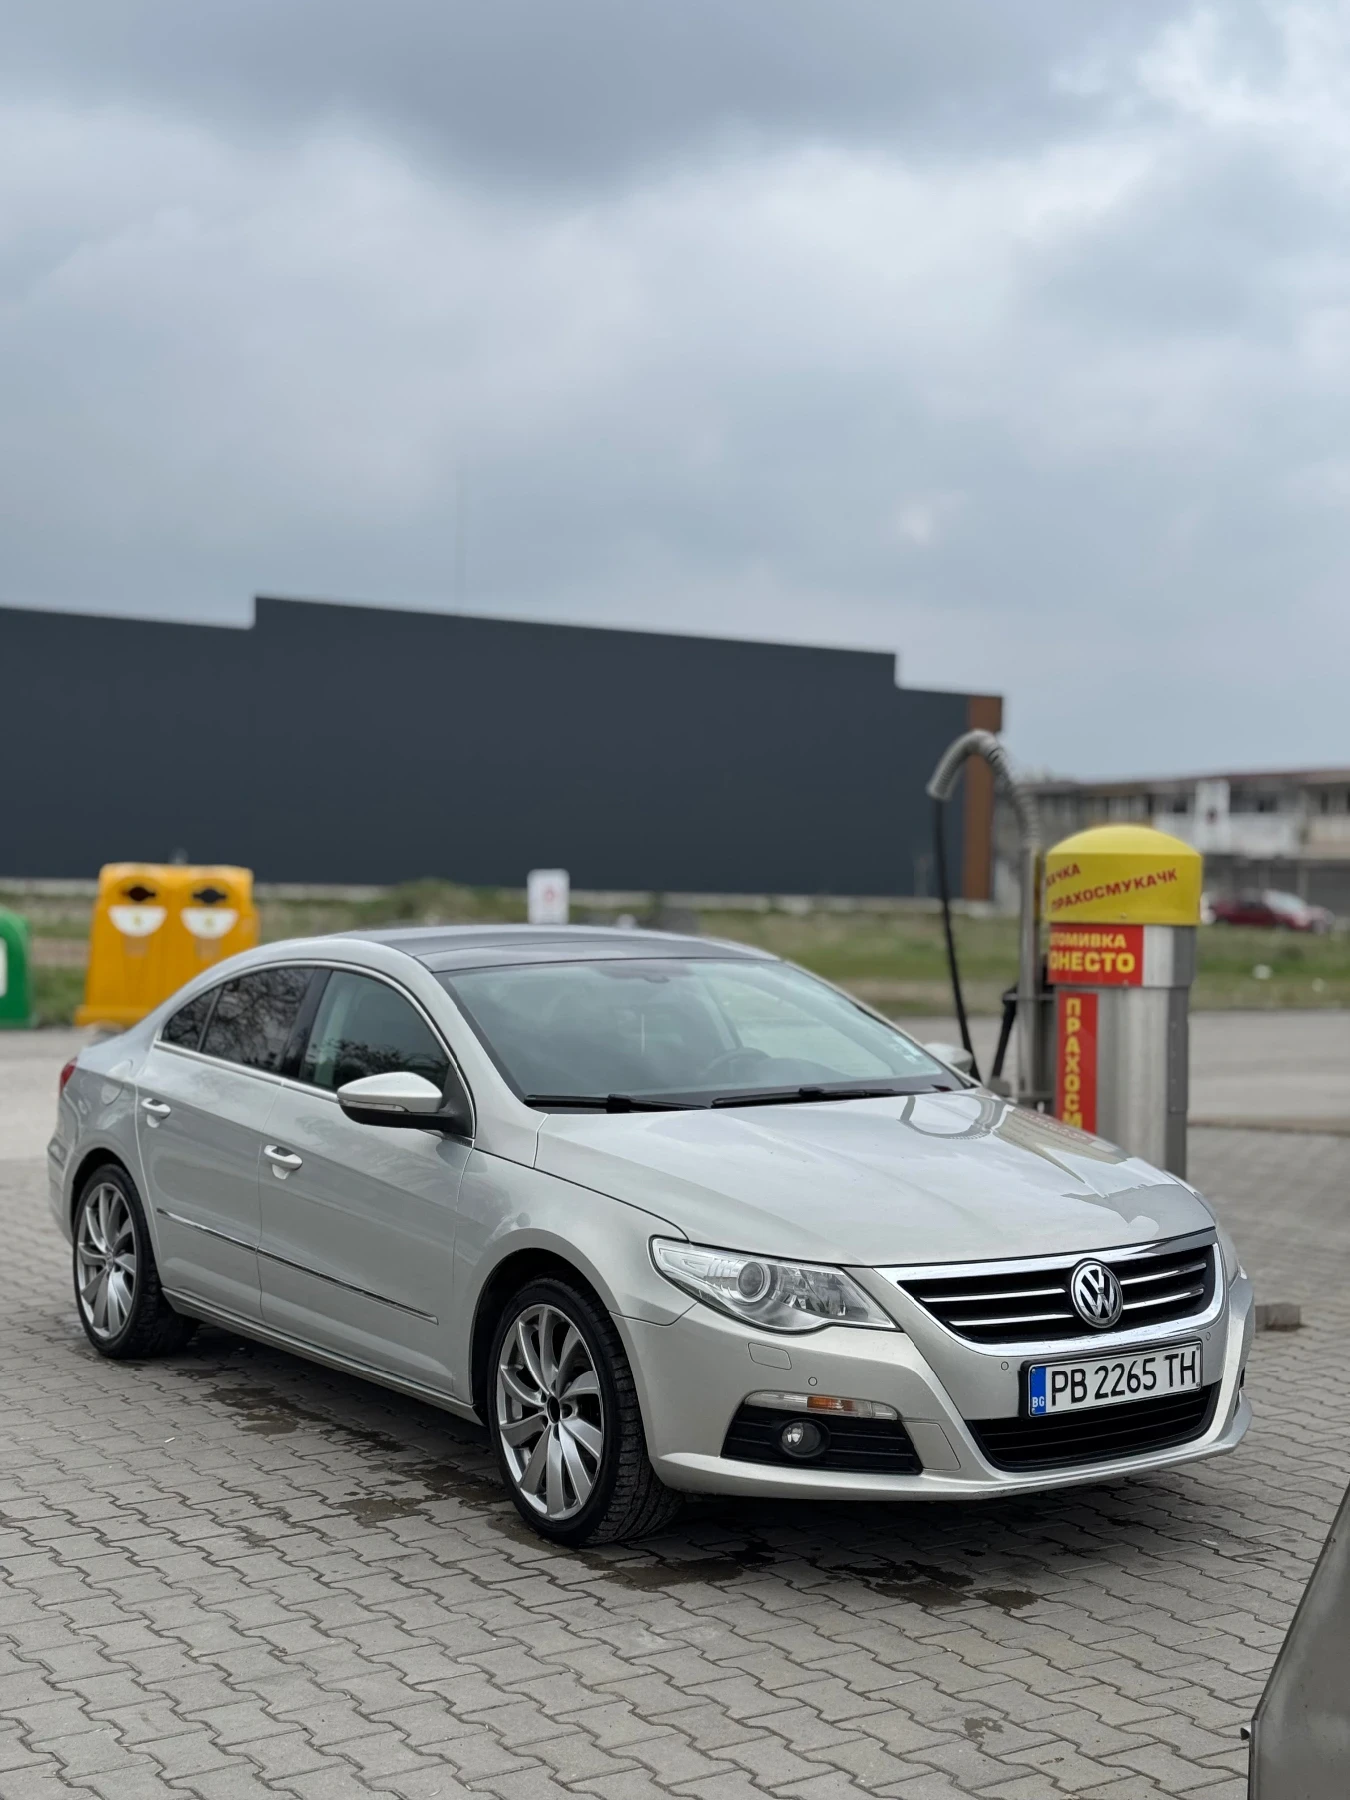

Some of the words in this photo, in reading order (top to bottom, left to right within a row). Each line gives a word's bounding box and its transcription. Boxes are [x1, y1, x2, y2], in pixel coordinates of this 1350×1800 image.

[1051, 1368, 1088, 1407] PB
[1094, 1357, 1157, 1400] 2265
[1164, 1350, 1197, 1388] TH
[1032, 1396, 1045, 1408] BG
